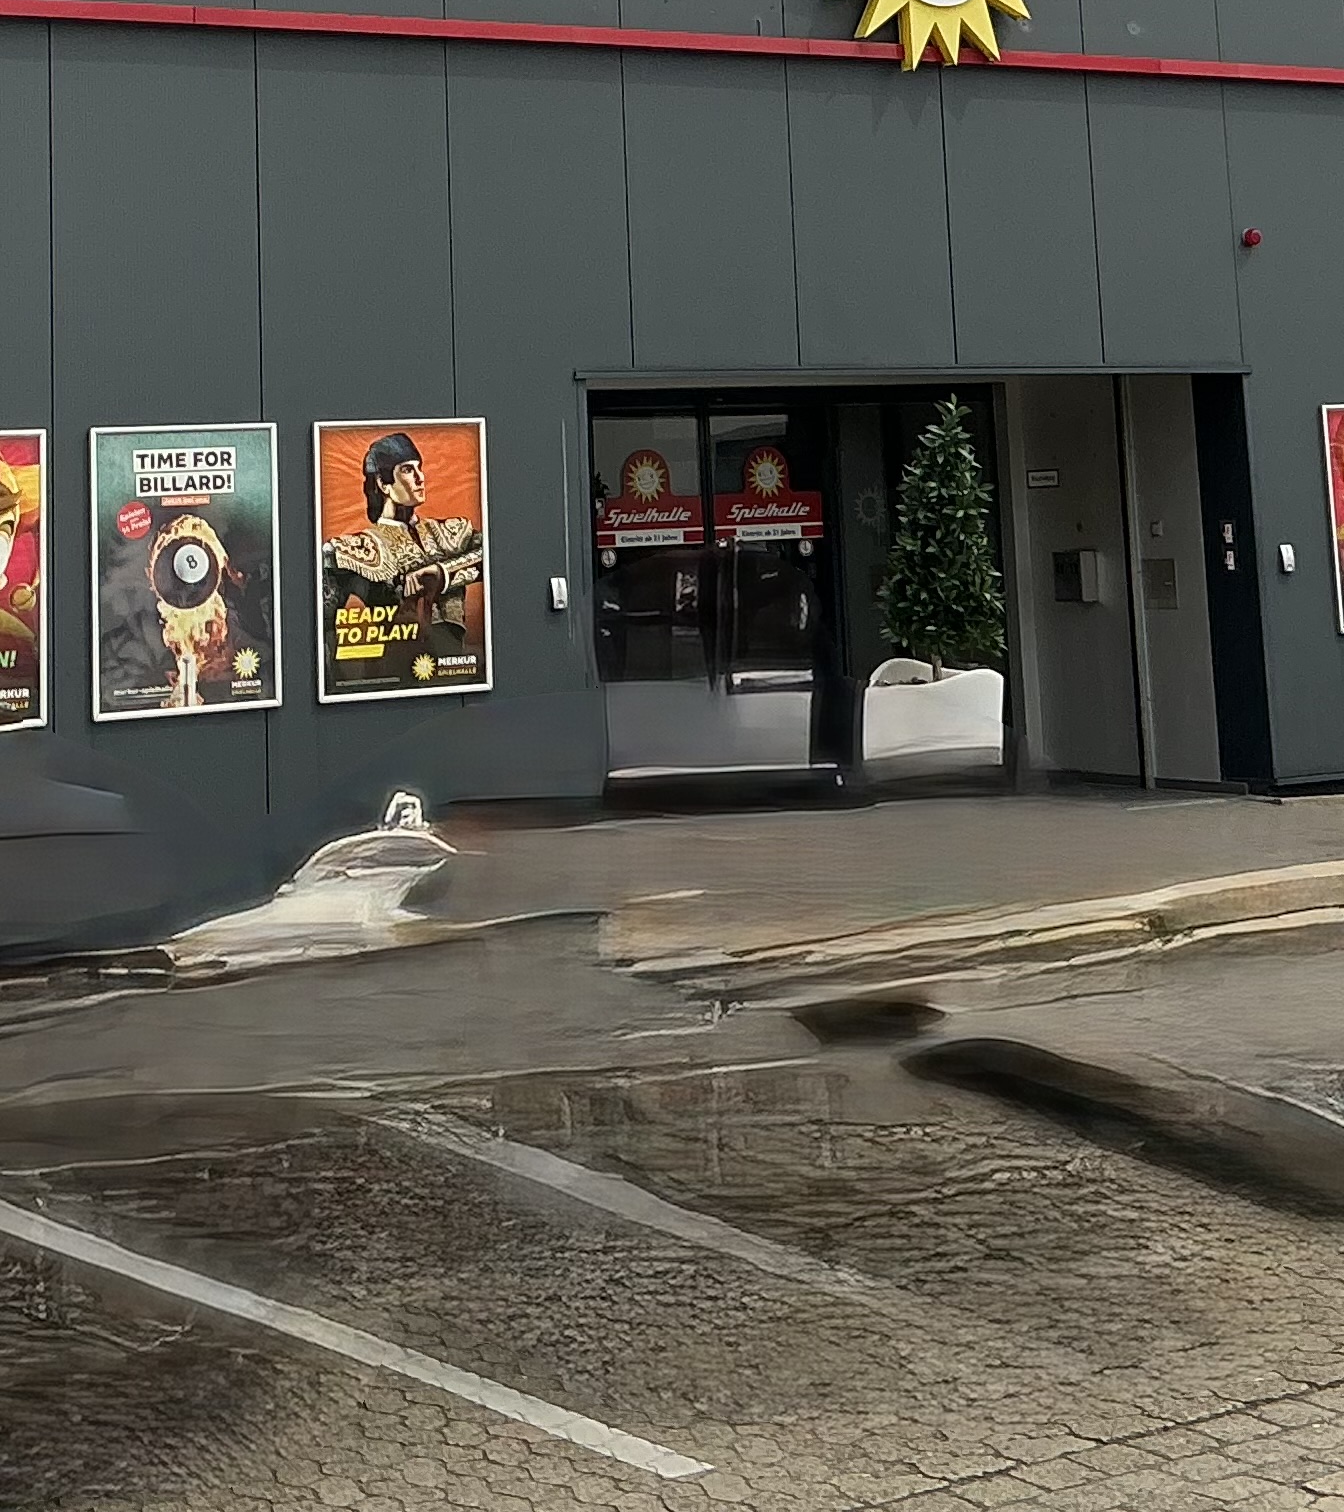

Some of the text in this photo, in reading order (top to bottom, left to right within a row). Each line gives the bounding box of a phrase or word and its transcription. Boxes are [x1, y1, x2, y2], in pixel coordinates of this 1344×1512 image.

[136, 451, 233, 469] TIME FOR
[139, 474, 232, 493] BILLARD!
[604, 507, 692, 528] Spielhalle
[726, 502, 810, 522] Spielhalle
[186, 555, 198, 569] 8
[336, 605, 398, 625] READY
[336, 623, 419, 645] TO PLAY!
[437, 655, 476, 666] MERKUR
